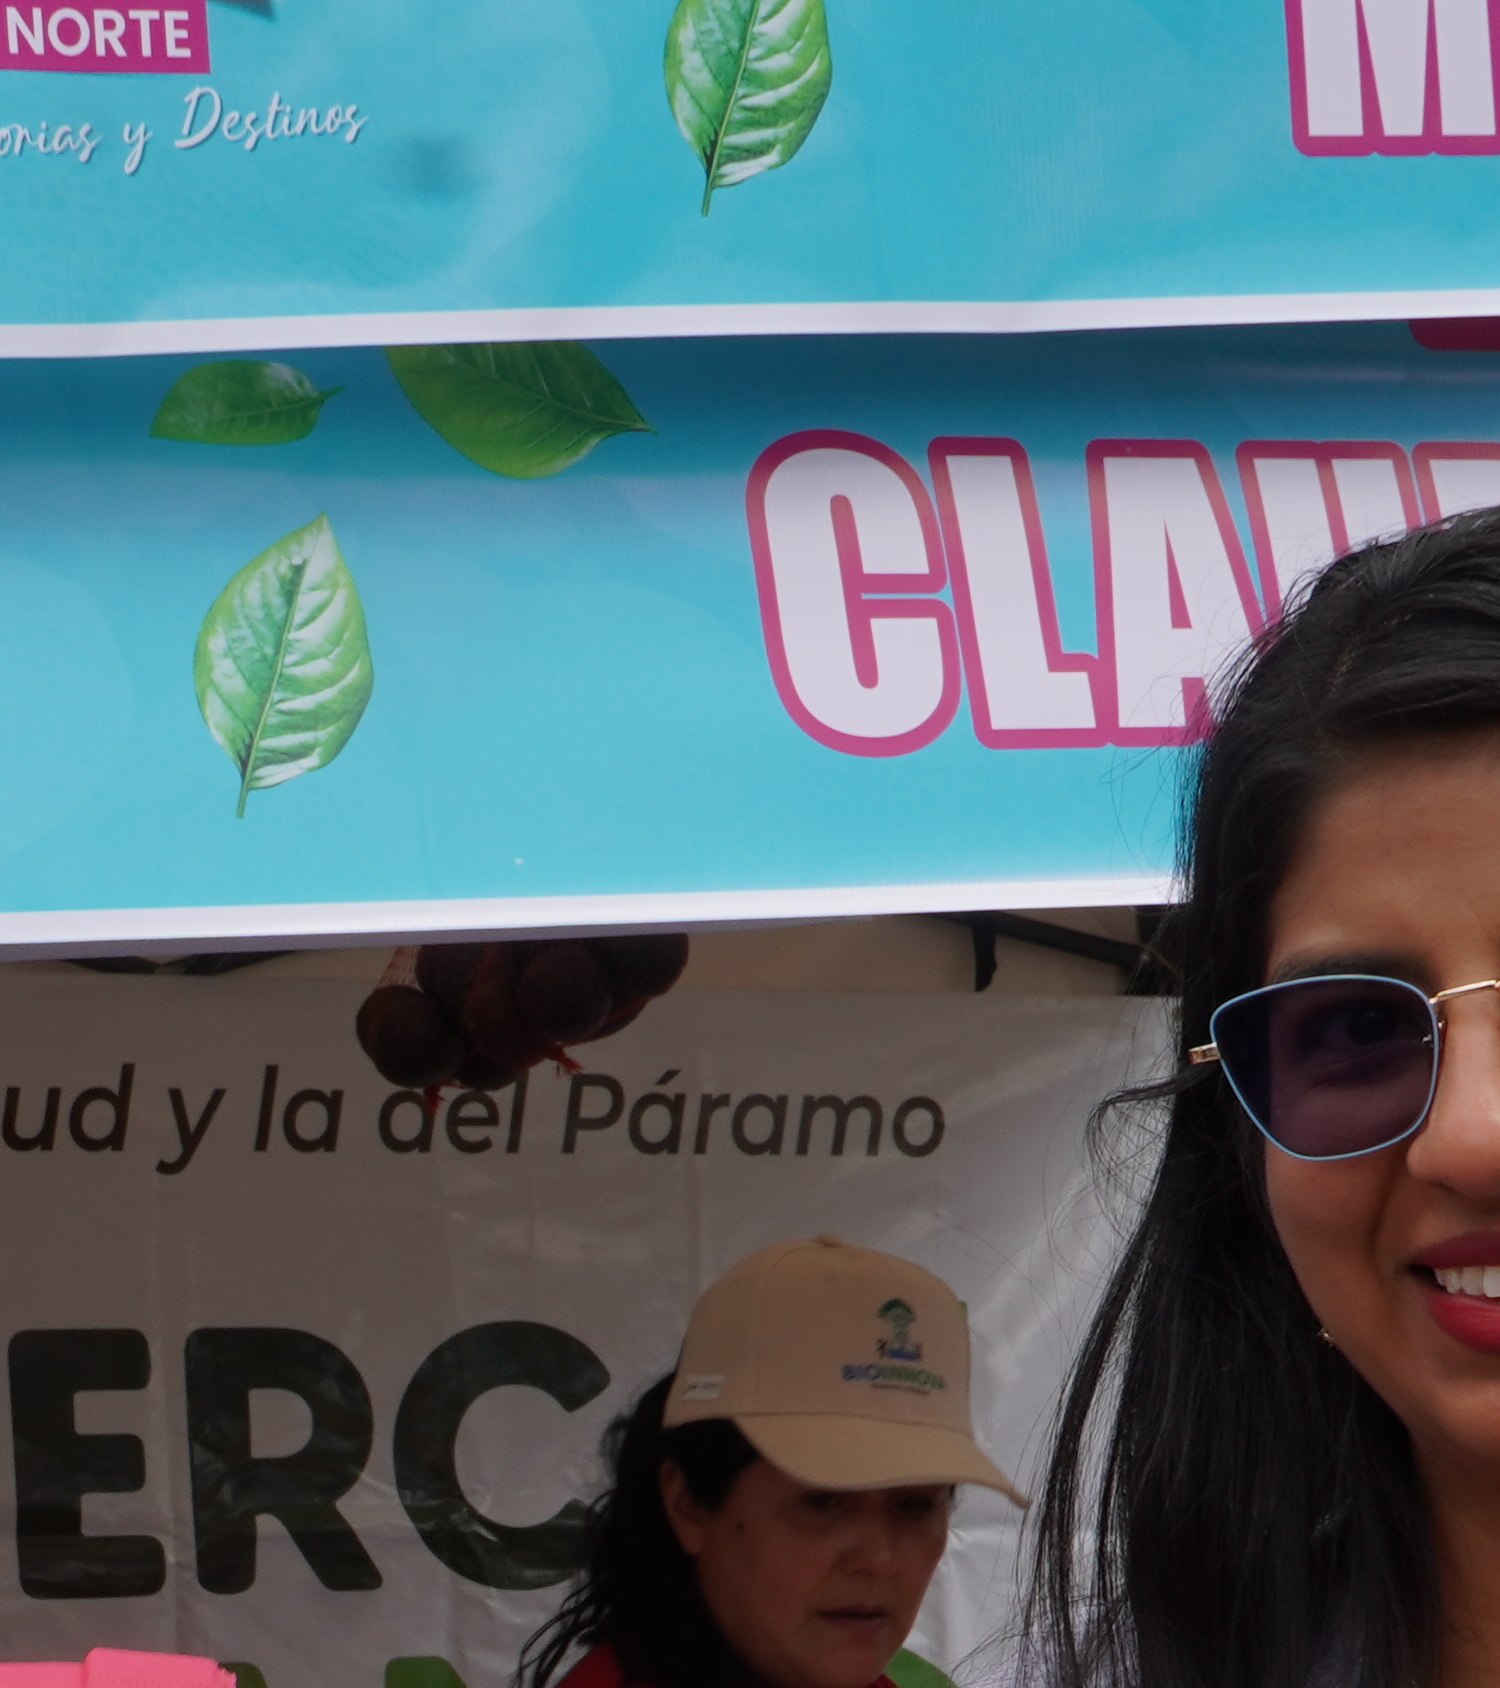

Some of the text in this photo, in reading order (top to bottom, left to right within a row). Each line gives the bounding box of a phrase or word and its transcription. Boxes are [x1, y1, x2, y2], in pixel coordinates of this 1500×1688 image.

[6, 8, 193, 59] NORTE
[121, 122, 154, 174] y
[174, 86, 370, 150] Destinos
[155, 1087, 227, 1176] y
[252, 1064, 344, 1154] la
[560, 1068, 947, 1158] Páramo
